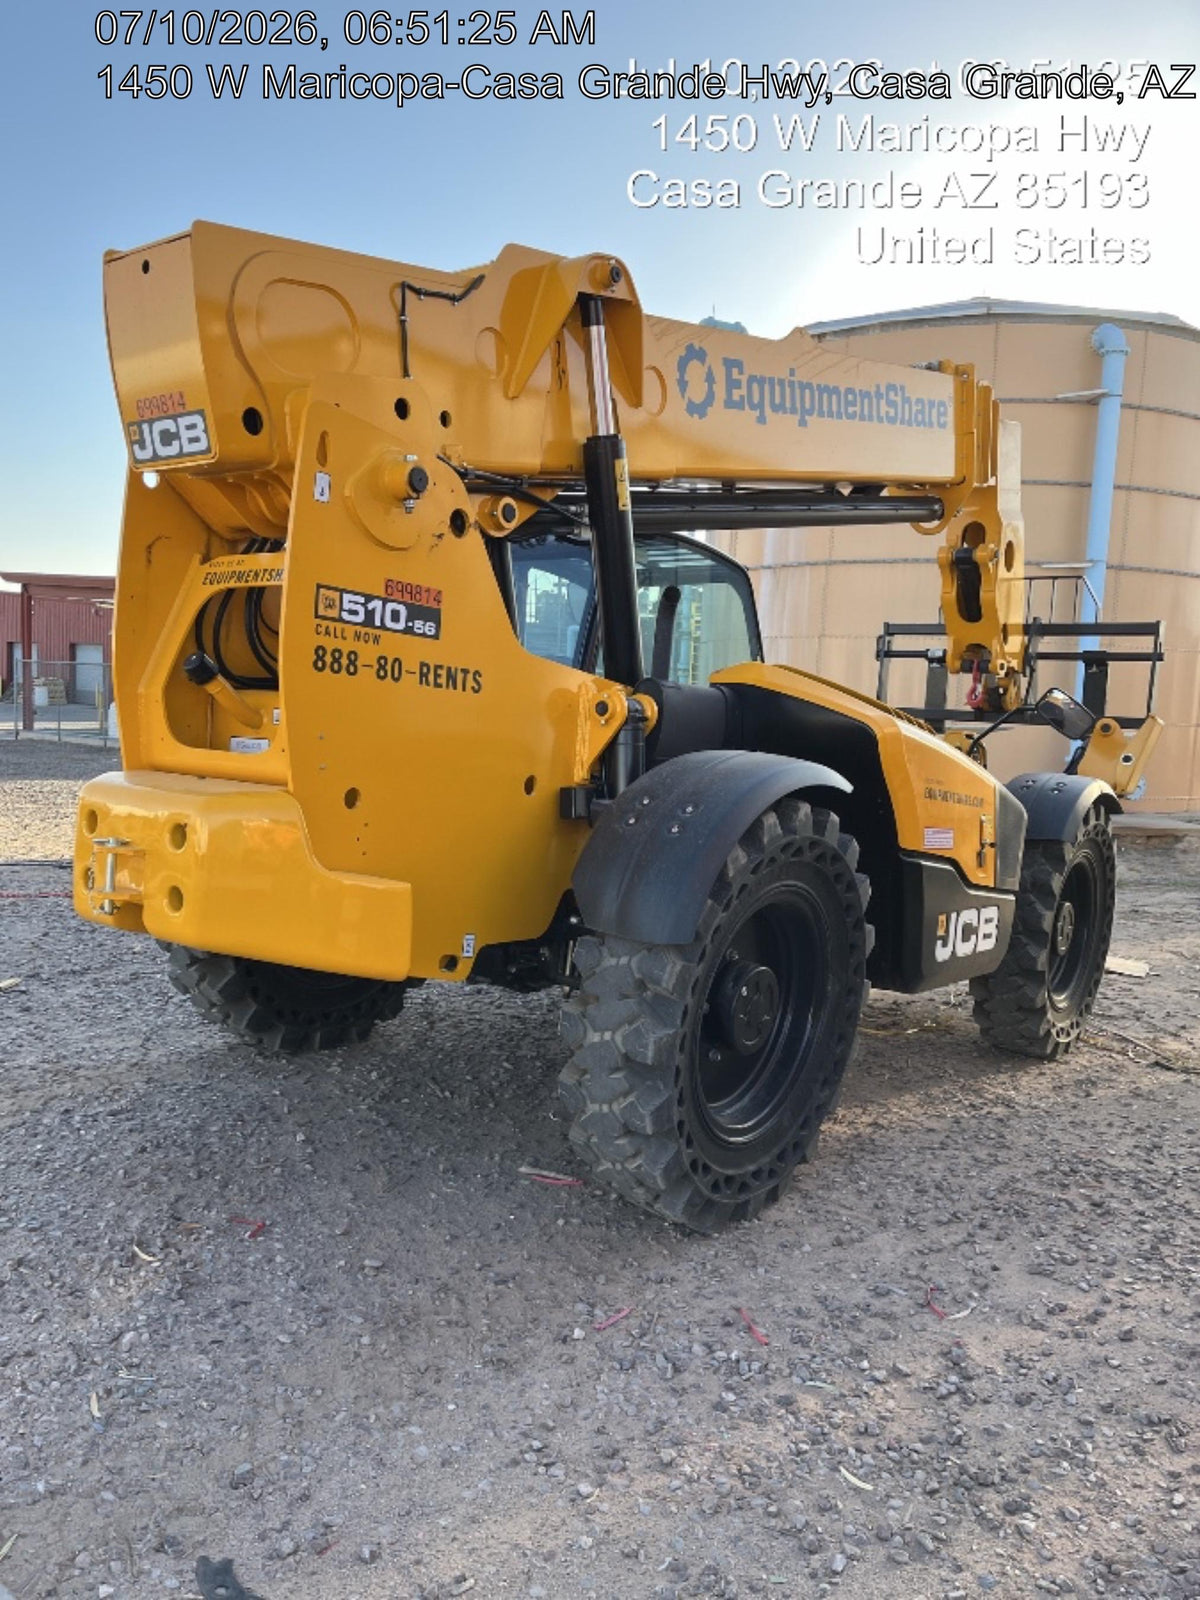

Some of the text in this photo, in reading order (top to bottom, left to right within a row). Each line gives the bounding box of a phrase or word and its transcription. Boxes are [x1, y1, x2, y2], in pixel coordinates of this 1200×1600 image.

[721, 357, 948, 429] EquipmentShare
[132, 414, 209, 460] JCB
[384, 578, 443, 607] 699814
[314, 622, 382, 646] CALL NOW
[312, 645, 483, 695] 888-80-RENTS
[935, 905, 999, 963] JCB
